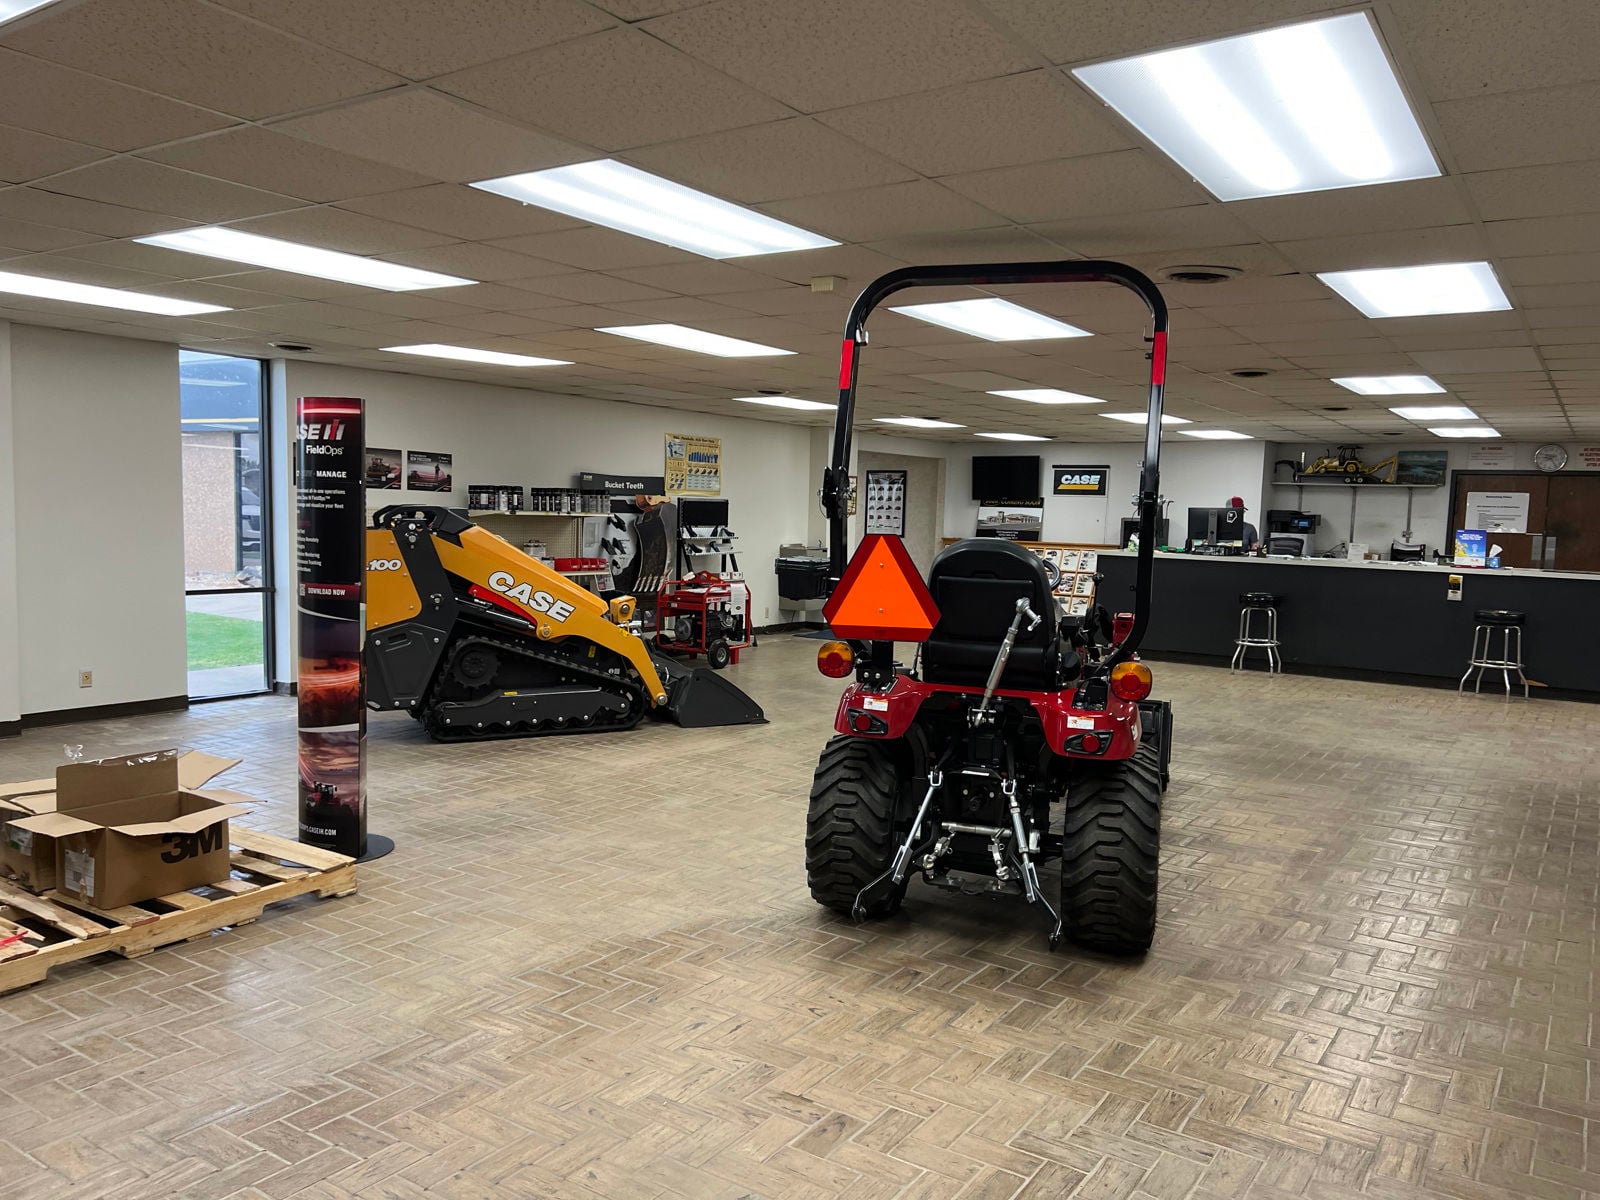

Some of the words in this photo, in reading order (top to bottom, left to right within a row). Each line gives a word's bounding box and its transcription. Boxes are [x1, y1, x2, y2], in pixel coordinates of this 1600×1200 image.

[296, 423, 321, 440] SE
[316, 470, 347, 478] MANAGE
[1061, 474, 1101, 485] CASE
[604, 480, 625, 489] Bucket
[625, 481, 644, 490] Teeth
[366, 559, 402, 571] 100
[307, 587, 332, 595] DOWNLOAD
[488, 571, 576, 623] CASE
[161, 822, 223, 864] 3M
